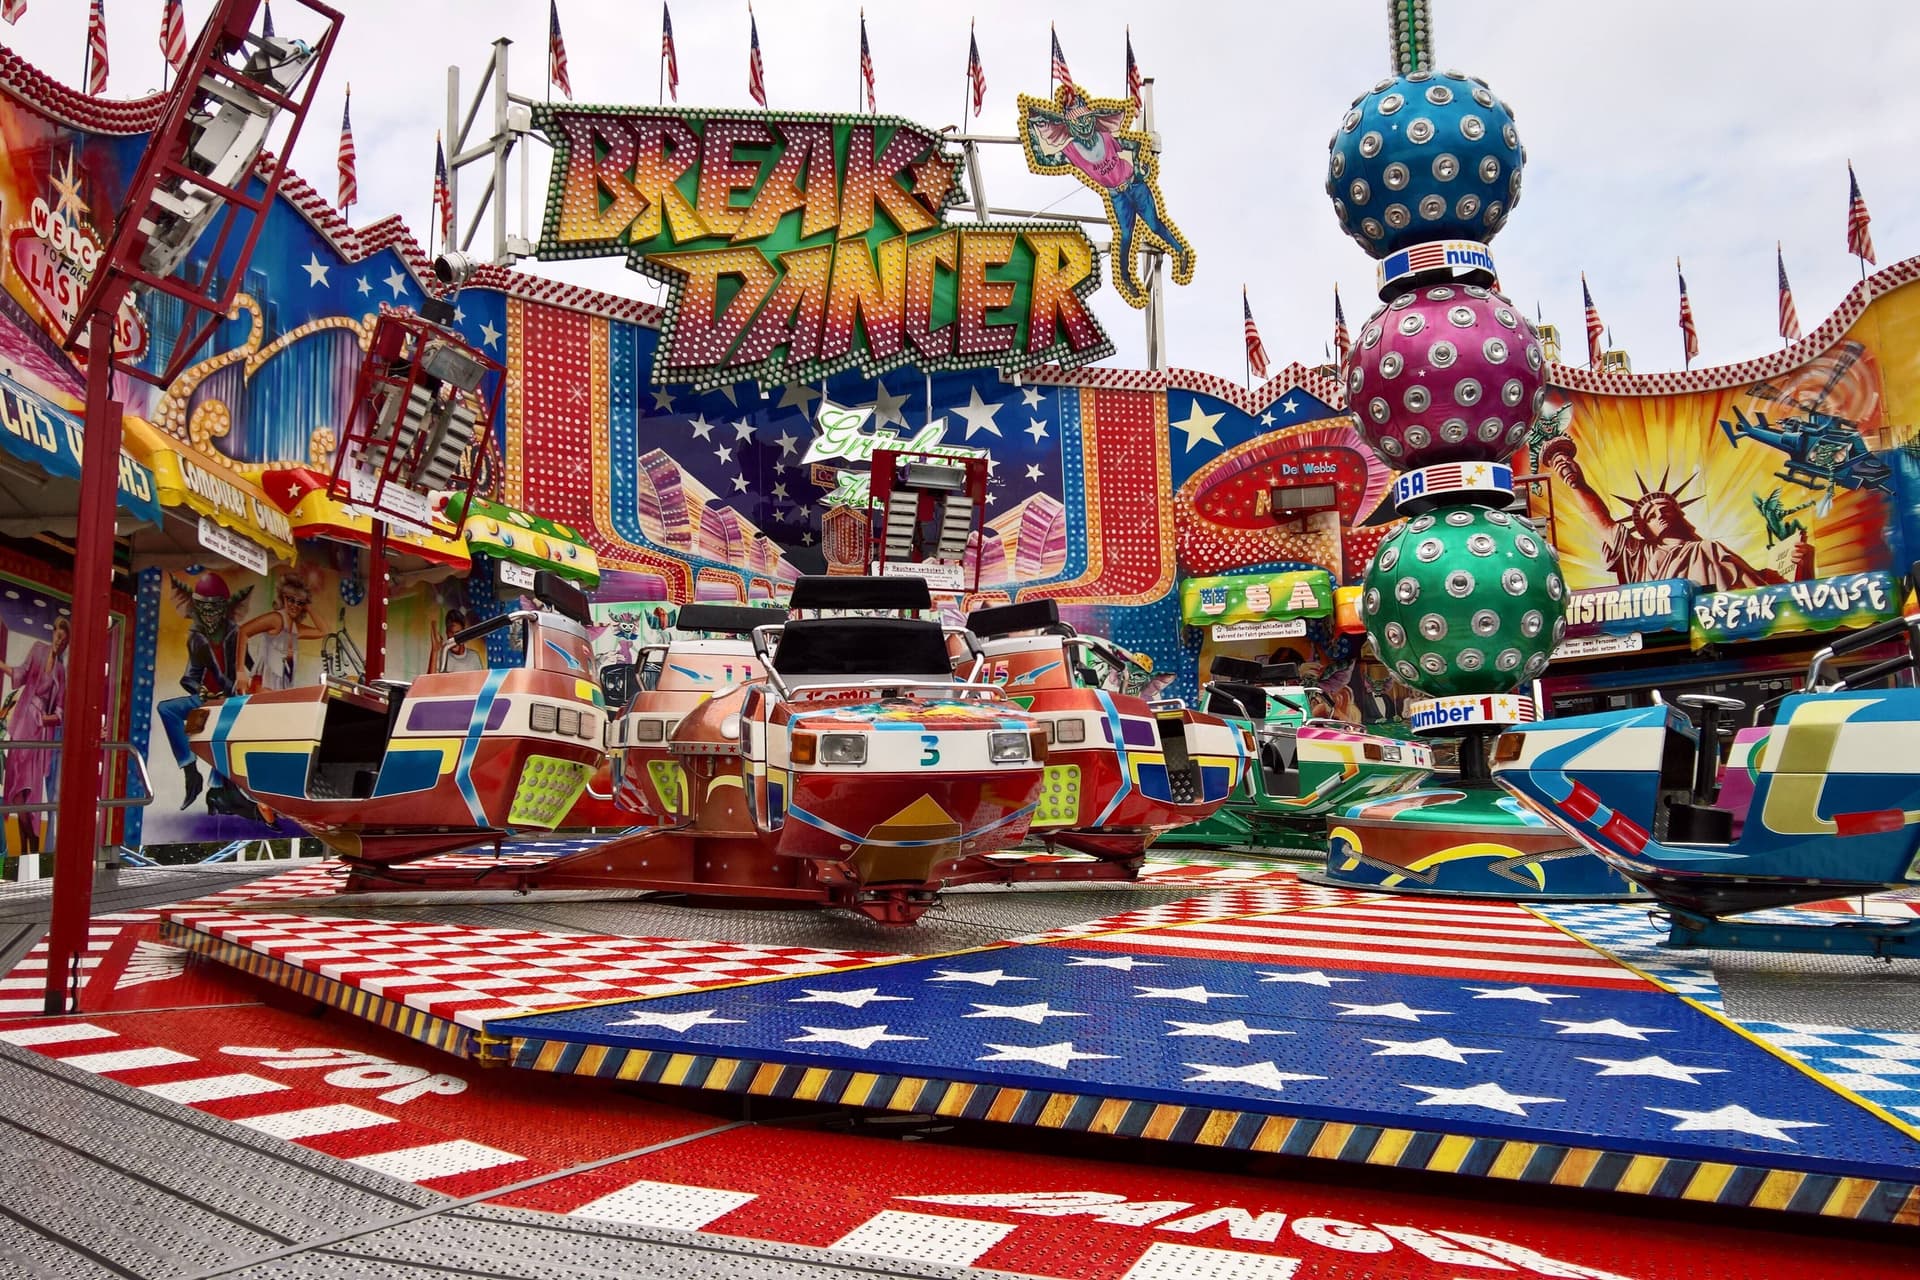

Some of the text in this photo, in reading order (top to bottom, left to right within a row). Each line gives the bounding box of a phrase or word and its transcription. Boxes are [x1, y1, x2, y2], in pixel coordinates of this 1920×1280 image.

[553, 112, 940, 244] BREAK
[30, 254, 70, 306] LAS
[646, 227, 1101, 368] DANCER
[177, 454, 248, 519] Computer
[1303, 461, 1337, 474] Webbs
[1200, 581, 1319, 615] USA
[1695, 578, 1886, 630] BREAK HOUSE
[981, 660, 1009, 687] 15
[1411, 696, 1493, 728] number 1
[920, 735, 940, 766] 3
[219, 1046, 468, 1104] STOP
